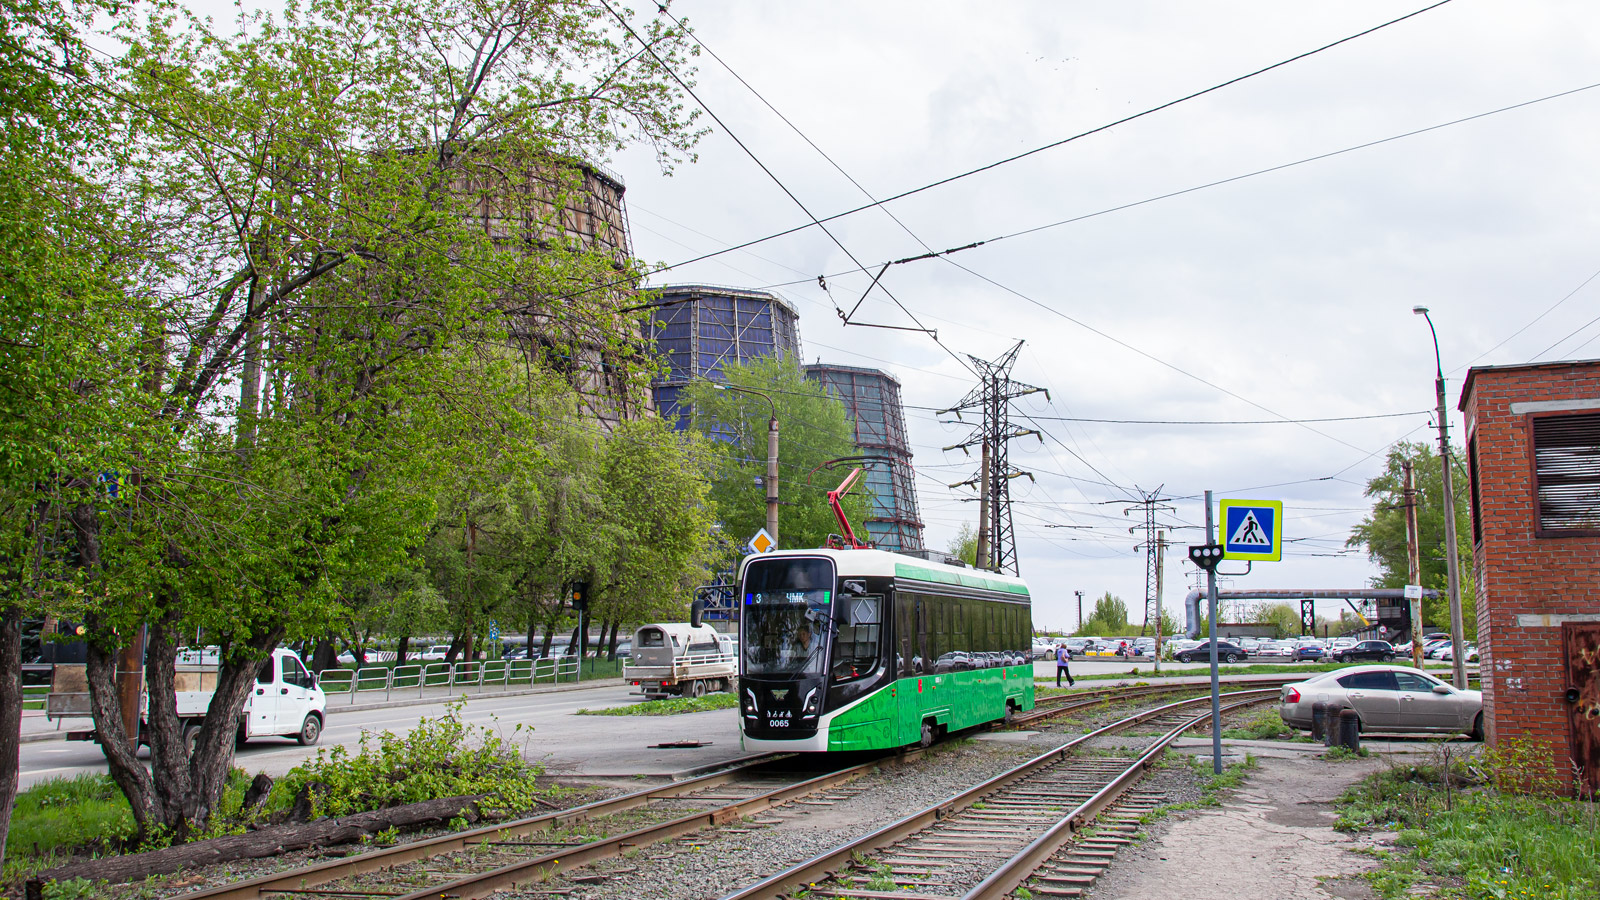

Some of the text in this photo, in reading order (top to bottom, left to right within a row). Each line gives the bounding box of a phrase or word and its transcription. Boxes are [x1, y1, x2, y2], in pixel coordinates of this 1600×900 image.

[755, 592, 805, 604] 3 ЧМК
[769, 719, 790, 728] 0065
